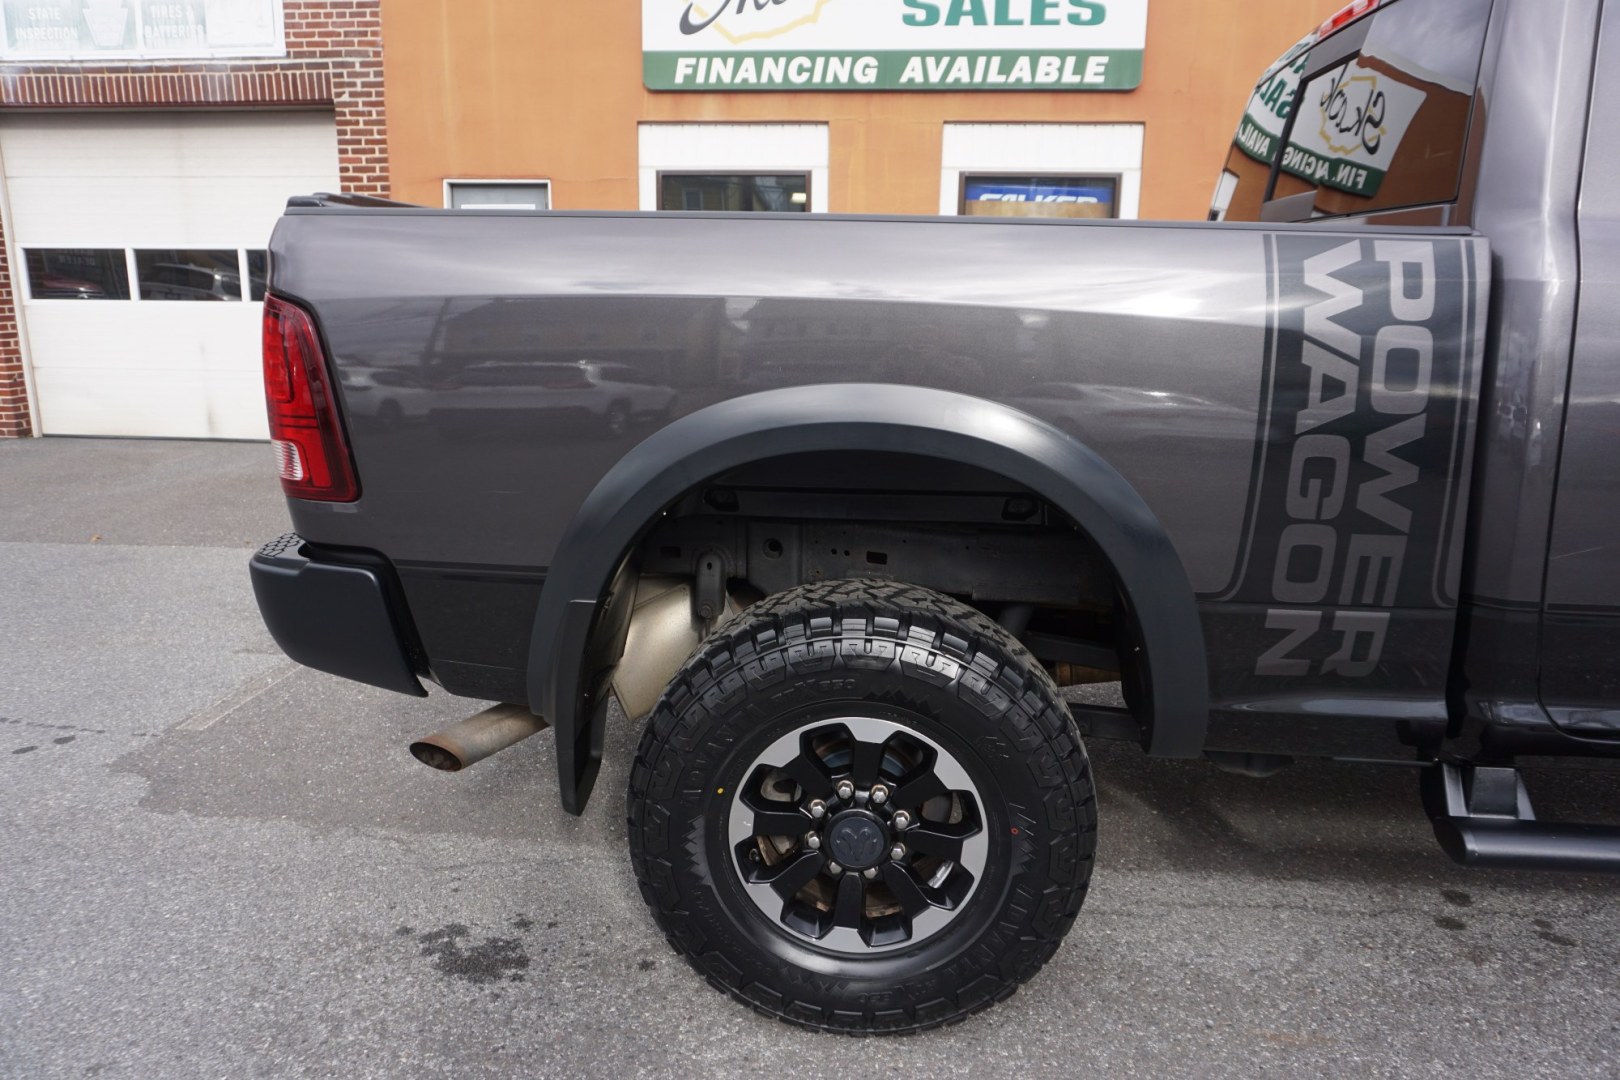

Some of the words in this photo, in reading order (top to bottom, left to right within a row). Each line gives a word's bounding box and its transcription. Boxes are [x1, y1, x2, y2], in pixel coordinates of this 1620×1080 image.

[28, 7, 61, 20] STATE
[151, 5, 183, 19] TIRES
[902, 0, 1106, 26] SALES
[15, 26, 78, 40] INSPECTION
[674, 56, 879, 84] FINANCING
[899, 56, 1109, 83] AVAILABLE
[1254, 239, 1364, 677] WAGON
[1320, 240, 1436, 677] POWER
